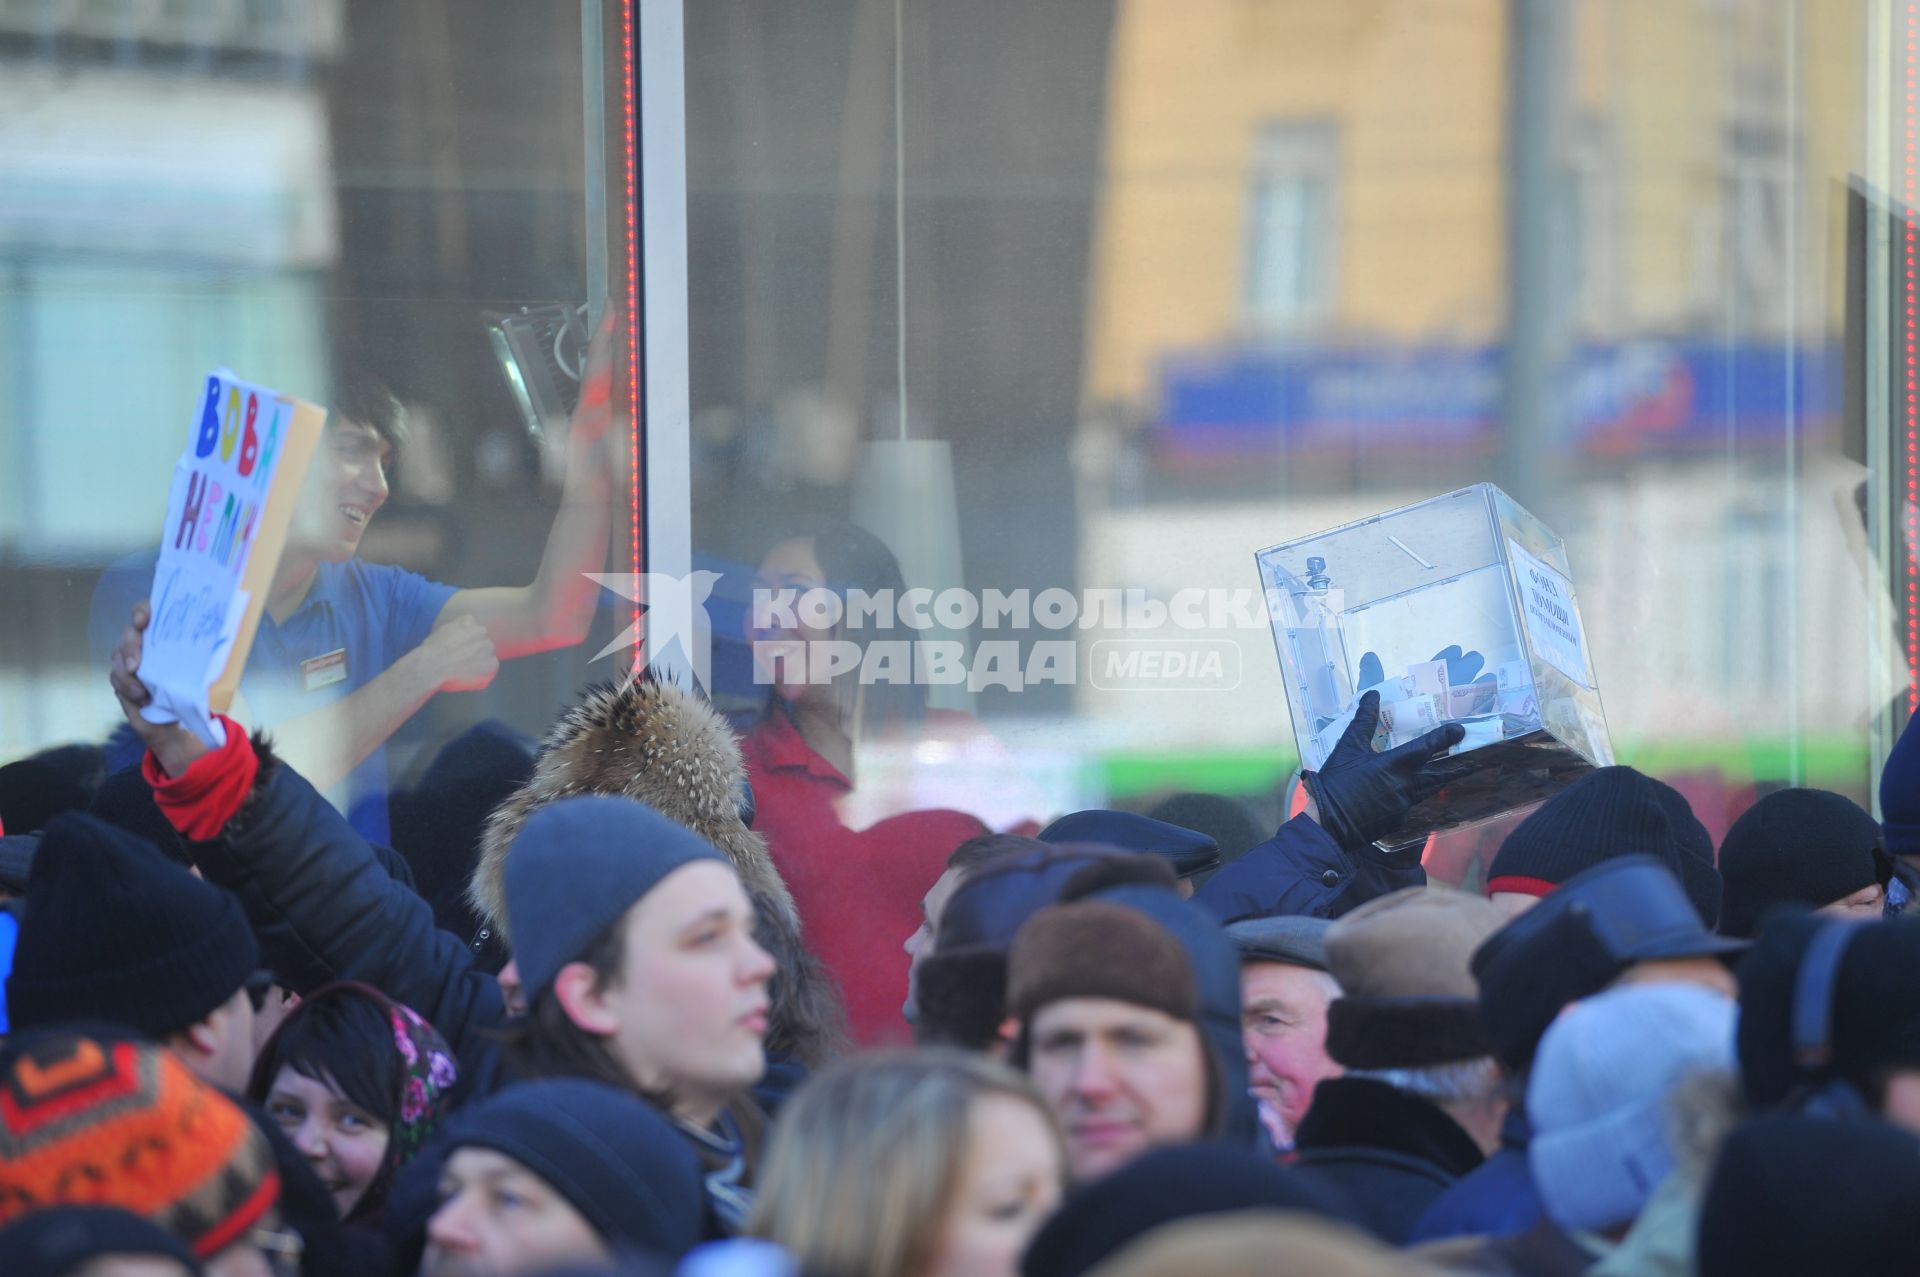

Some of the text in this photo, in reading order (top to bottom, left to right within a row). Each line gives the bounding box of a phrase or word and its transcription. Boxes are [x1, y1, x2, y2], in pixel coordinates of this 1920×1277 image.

[196, 376, 278, 489] ВОВА
[1530, 568, 1558, 599] ФОНД
[1531, 588, 1569, 626] ПОМОЩИ
